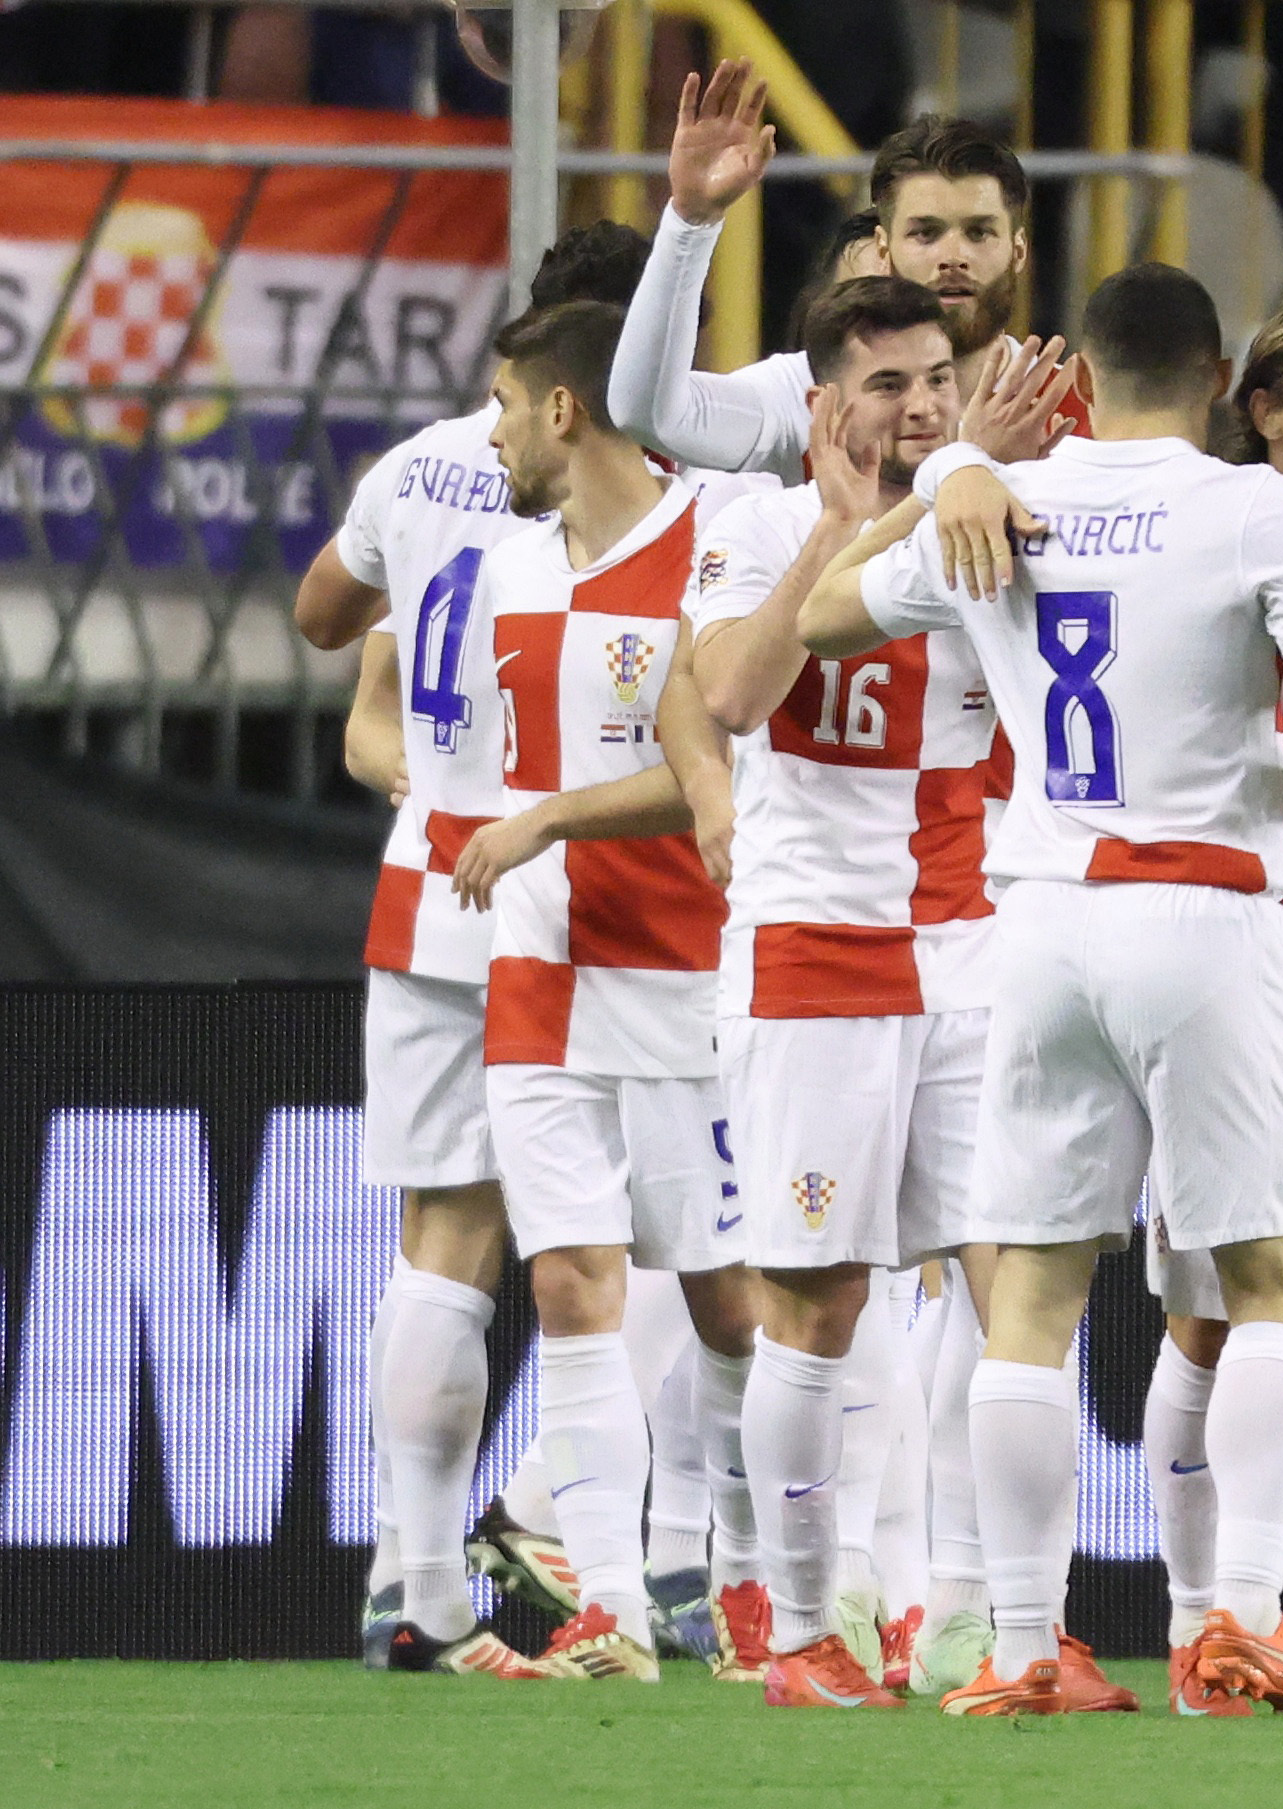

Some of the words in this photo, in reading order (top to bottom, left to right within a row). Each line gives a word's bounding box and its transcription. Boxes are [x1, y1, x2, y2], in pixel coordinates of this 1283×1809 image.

[1003, 502, 1169, 557] OVAČIĆ
[411, 546, 484, 754] 4
[813, 659, 891, 750] 16
[1036, 591, 1125, 808] 8
